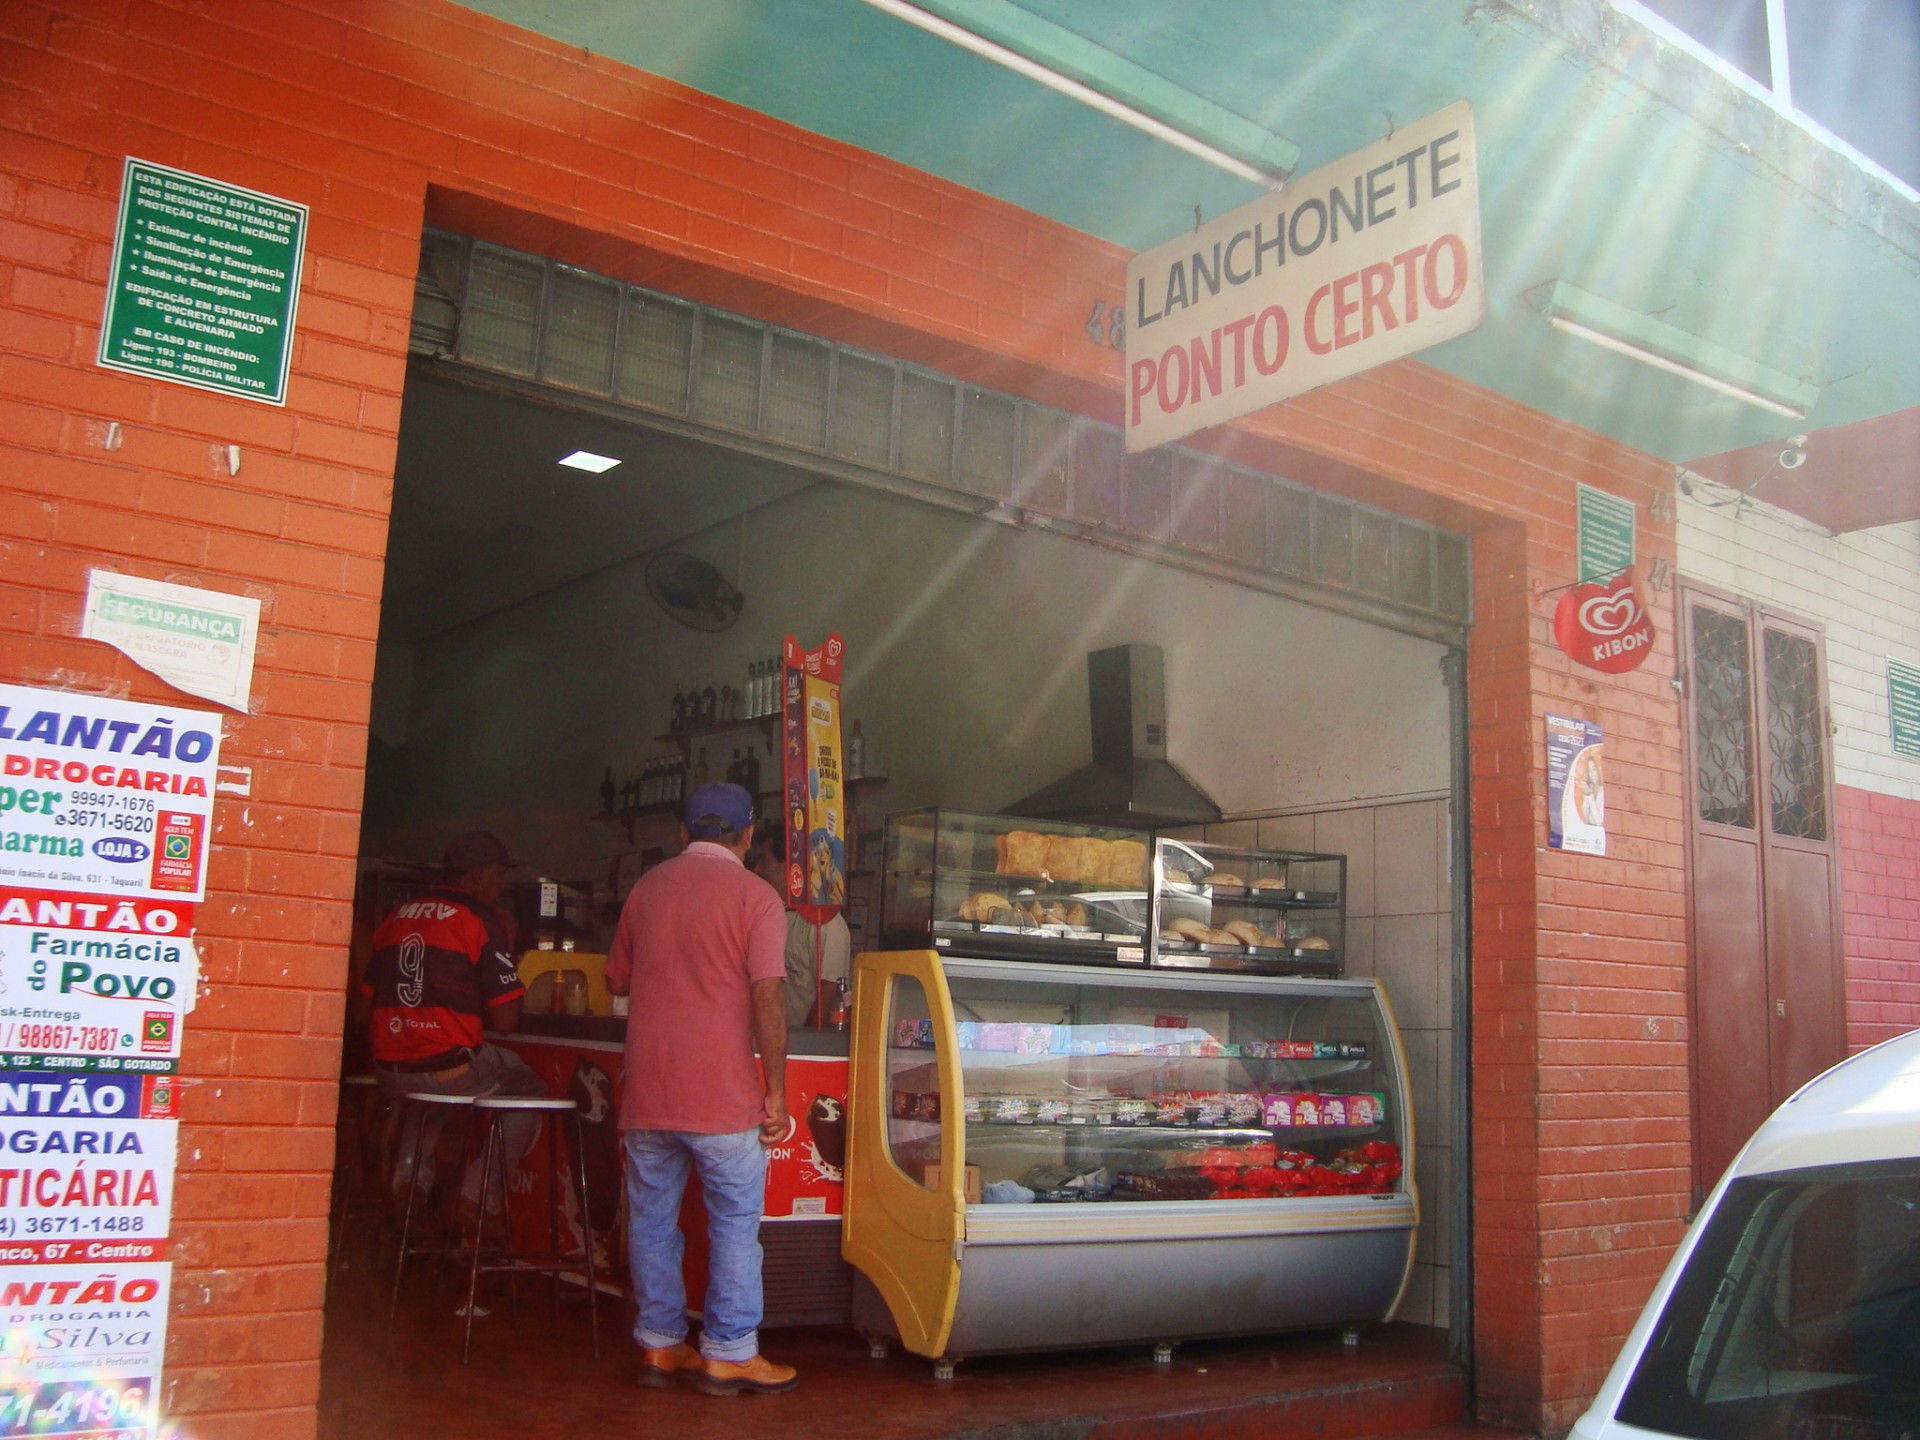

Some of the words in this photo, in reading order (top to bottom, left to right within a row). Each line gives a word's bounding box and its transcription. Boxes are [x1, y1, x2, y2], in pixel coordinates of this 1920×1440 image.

[135, 173, 162, 186] ESTA
[165, 181, 227, 204] EDIFICAÇÃO
[230, 199, 256, 212] ESTÁ
[258, 206, 297, 223] DOTADA
[139, 186, 161, 199] DOS
[164, 193, 223, 214] SEGUINTES
[225, 209, 275, 229] SISTEMAS
[278, 224, 291, 233] DE
[137, 199, 193, 220] PROTEÇÃO
[196, 213, 238, 232] CONTRA
[241, 225, 289, 245] INCÊNDIO
[1138, 130, 1461, 328] LANCHONETE
[148, 222, 190, 240] Extintor
[193, 233, 206, 243] de
[209, 237, 252, 256] incêndio
[143, 251, 202, 273] Iluminação
[205, 267, 217, 277] de
[220, 272, 281, 293] Emergência
[146, 236, 206, 259] Sinalização
[209, 253, 222, 263] de
[225, 257, 285, 279] Emergência
[174, 274, 187, 284] de
[190, 279, 251, 300] Emergência
[126, 283, 192, 306] EDIFICAÇÃO
[195, 300, 211, 311] EM
[214, 304, 278, 326] ESTRUTURA
[138, 298, 153, 307] DE
[156, 302, 215, 323] CONCRETO
[218, 316, 263, 334] ARMADO
[164, 315, 171, 323] E
[175, 319, 235, 339] ALVENARIA
[1131, 305, 1289, 427] PONTO
[1304, 234, 1467, 356] CERTO
[123, 339, 154, 353] Ligue:
[157, 347, 175, 357] 193
[183, 354, 237, 371] BOMBEIRO
[134, 328, 151, 338] EM
[154, 333, 185, 346] CASO
[187, 340, 202, 349] DE
[205, 343, 260, 364] INCÊNDIO:
[121, 350, 152, 364] Ligue:
[156, 359, 173, 368] 190
[182, 364, 222, 380] POLÍCIA
[225, 374, 265, 389] MILITAR
[104, 599, 235, 638] SEGURANÇA
[1593, 629, 1648, 661] KIBON
[0, 706, 214, 763] LANTÃO
[4, 754, 207, 797] DROGARIA
[0, 786, 62, 817] per
[71, 791, 154, 812] 99947-1676
[68, 810, 153, 833] 3671-5620
[0, 831, 84, 857] arma
[98, 843, 132, 859] LOJA
[134, 846, 144, 859] 2
[48, 871, 58, 879] da
[160, 860, 192, 869] FARMÁCIA
[160, 868, 192, 876] POPULAR
[0, 898, 177, 933] ANTÃO
[399, 902, 459, 920] MRV
[31, 932, 180, 963] Farmácia
[28, 959, 47, 990] do
[60, 961, 176, 999] Povo
[398, 932, 425, 1007] 9
[20, 1024, 119, 1051] 98867-7387
[405, 1019, 440, 1029] TOTAL
[12, 1056, 31, 1065] 123
[44, 1056, 86, 1068] CENTRO
[99, 1057, 119, 1068] SÃO
[124, 1059, 171, 1070] GOTARDO
[0, 1130, 144, 1154] GARIA
[0, 1160, 159, 1207] TICÁRIA
[26, 1217, 144, 1233] 3671-1488
[44, 1244, 71, 1258] 67
[88, 1243, 153, 1258] Centro
[9, 1311, 151, 1322] DROGARIA
[37, 1326, 152, 1350] Silva
